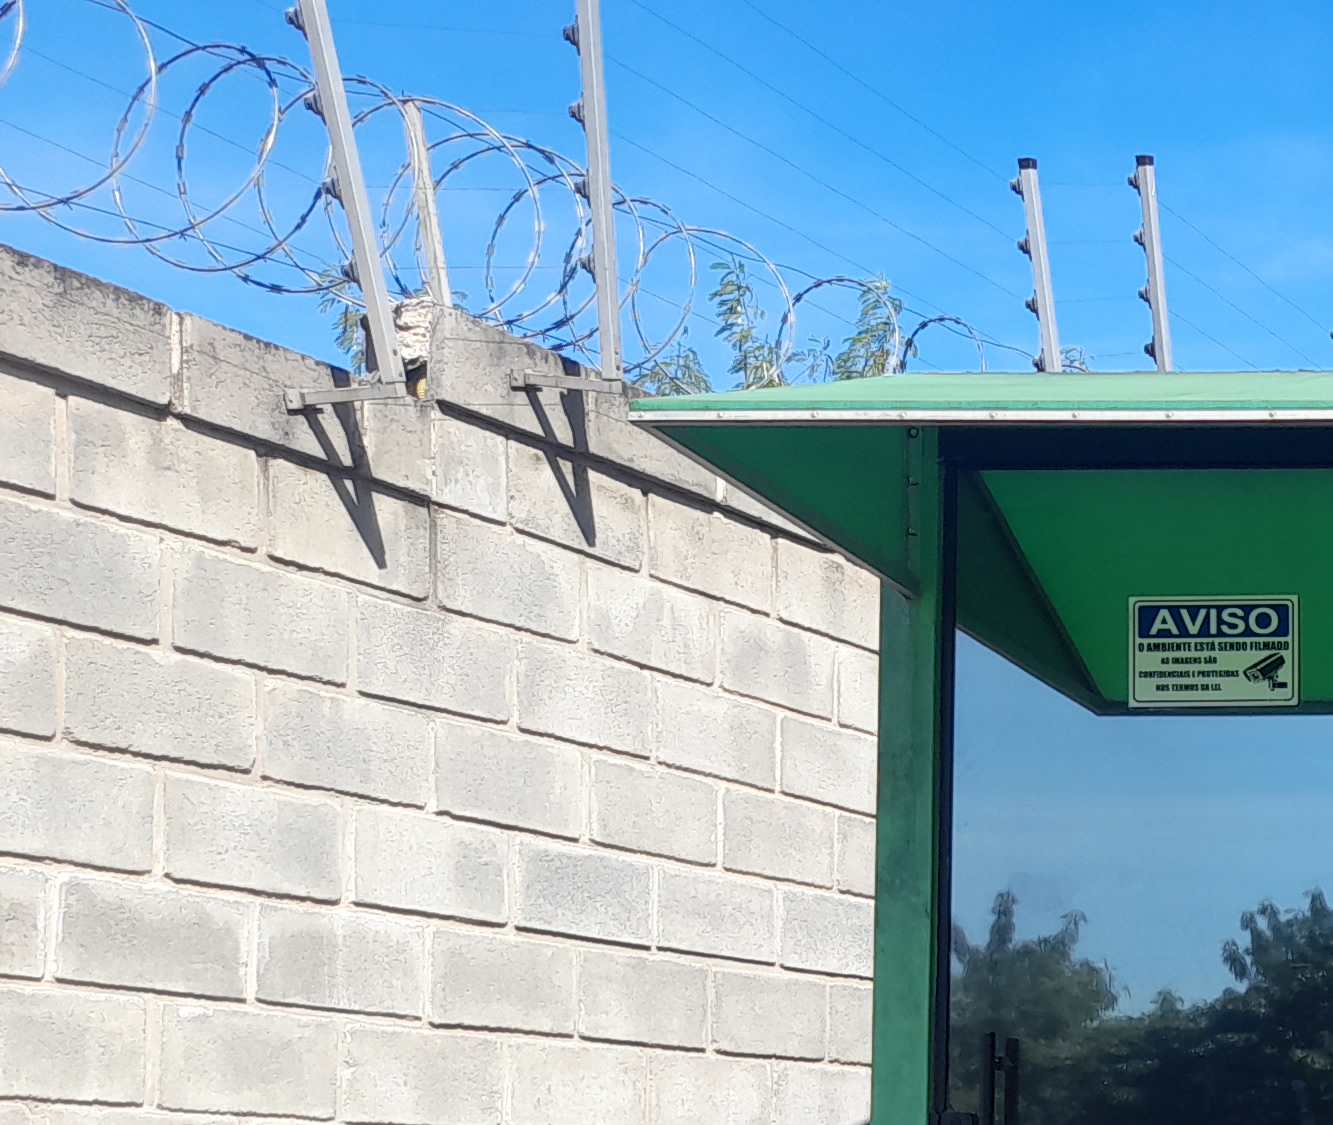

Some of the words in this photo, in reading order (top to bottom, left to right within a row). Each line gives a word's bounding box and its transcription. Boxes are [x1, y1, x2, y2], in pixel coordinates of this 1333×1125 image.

[1149, 607, 1279, 635] AVISO
[1138, 642, 1145, 652] O
[1146, 642, 1192, 652] AMBIENTE
[1194, 640, 1216, 652] ESTÁ
[1218, 641, 1248, 651] SENDO
[1250, 641, 1290, 651] FILMADO
[1161, 656, 1170, 665] AS
[1171, 656, 1202, 665] IMAGENS
[1204, 655, 1218, 665] SÃO
[1197, 670, 1240, 678] PROTEGIDAS
[1156, 683, 1170, 692] NOS
[1171, 683, 1199, 692] TERMOS
[1201, 683, 1210, 692] DA
